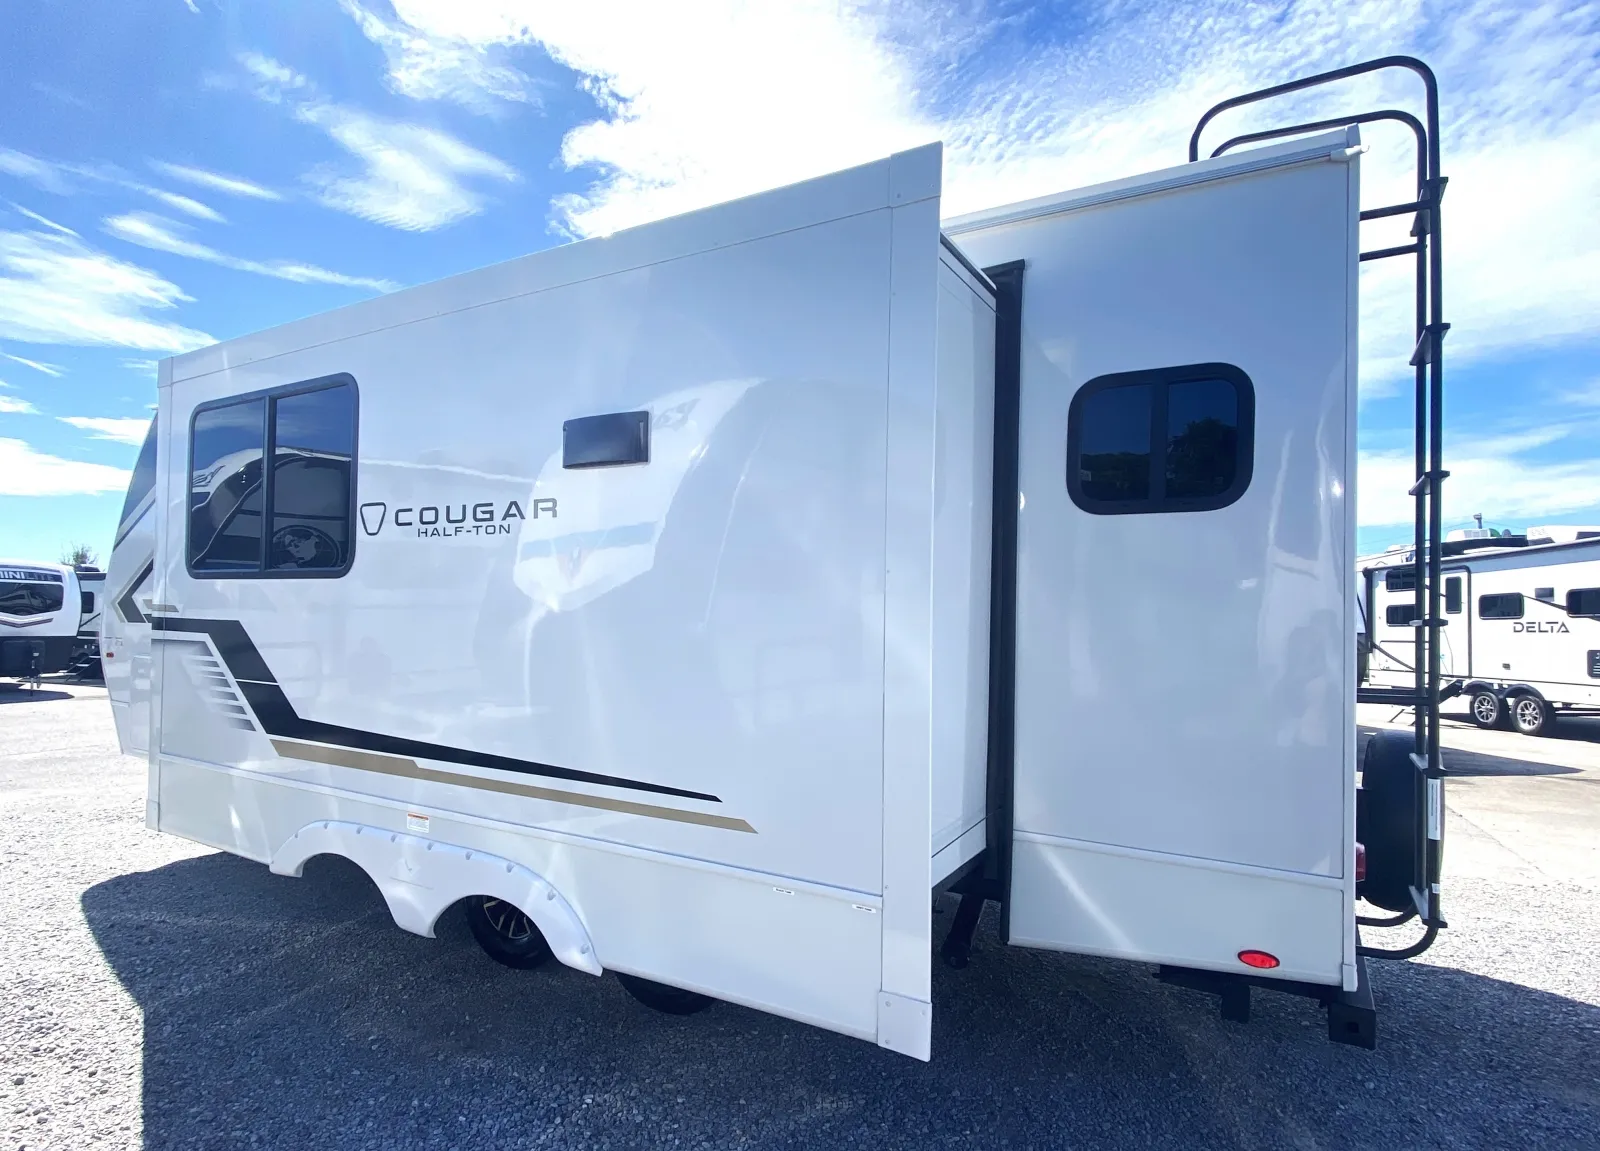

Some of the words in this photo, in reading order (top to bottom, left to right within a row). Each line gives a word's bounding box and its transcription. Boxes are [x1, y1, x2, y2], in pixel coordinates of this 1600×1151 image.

[394, 498, 558, 526] COUGAR
[417, 523, 511, 538] HALF-TON
[1513, 621, 1570, 633] DELTA
